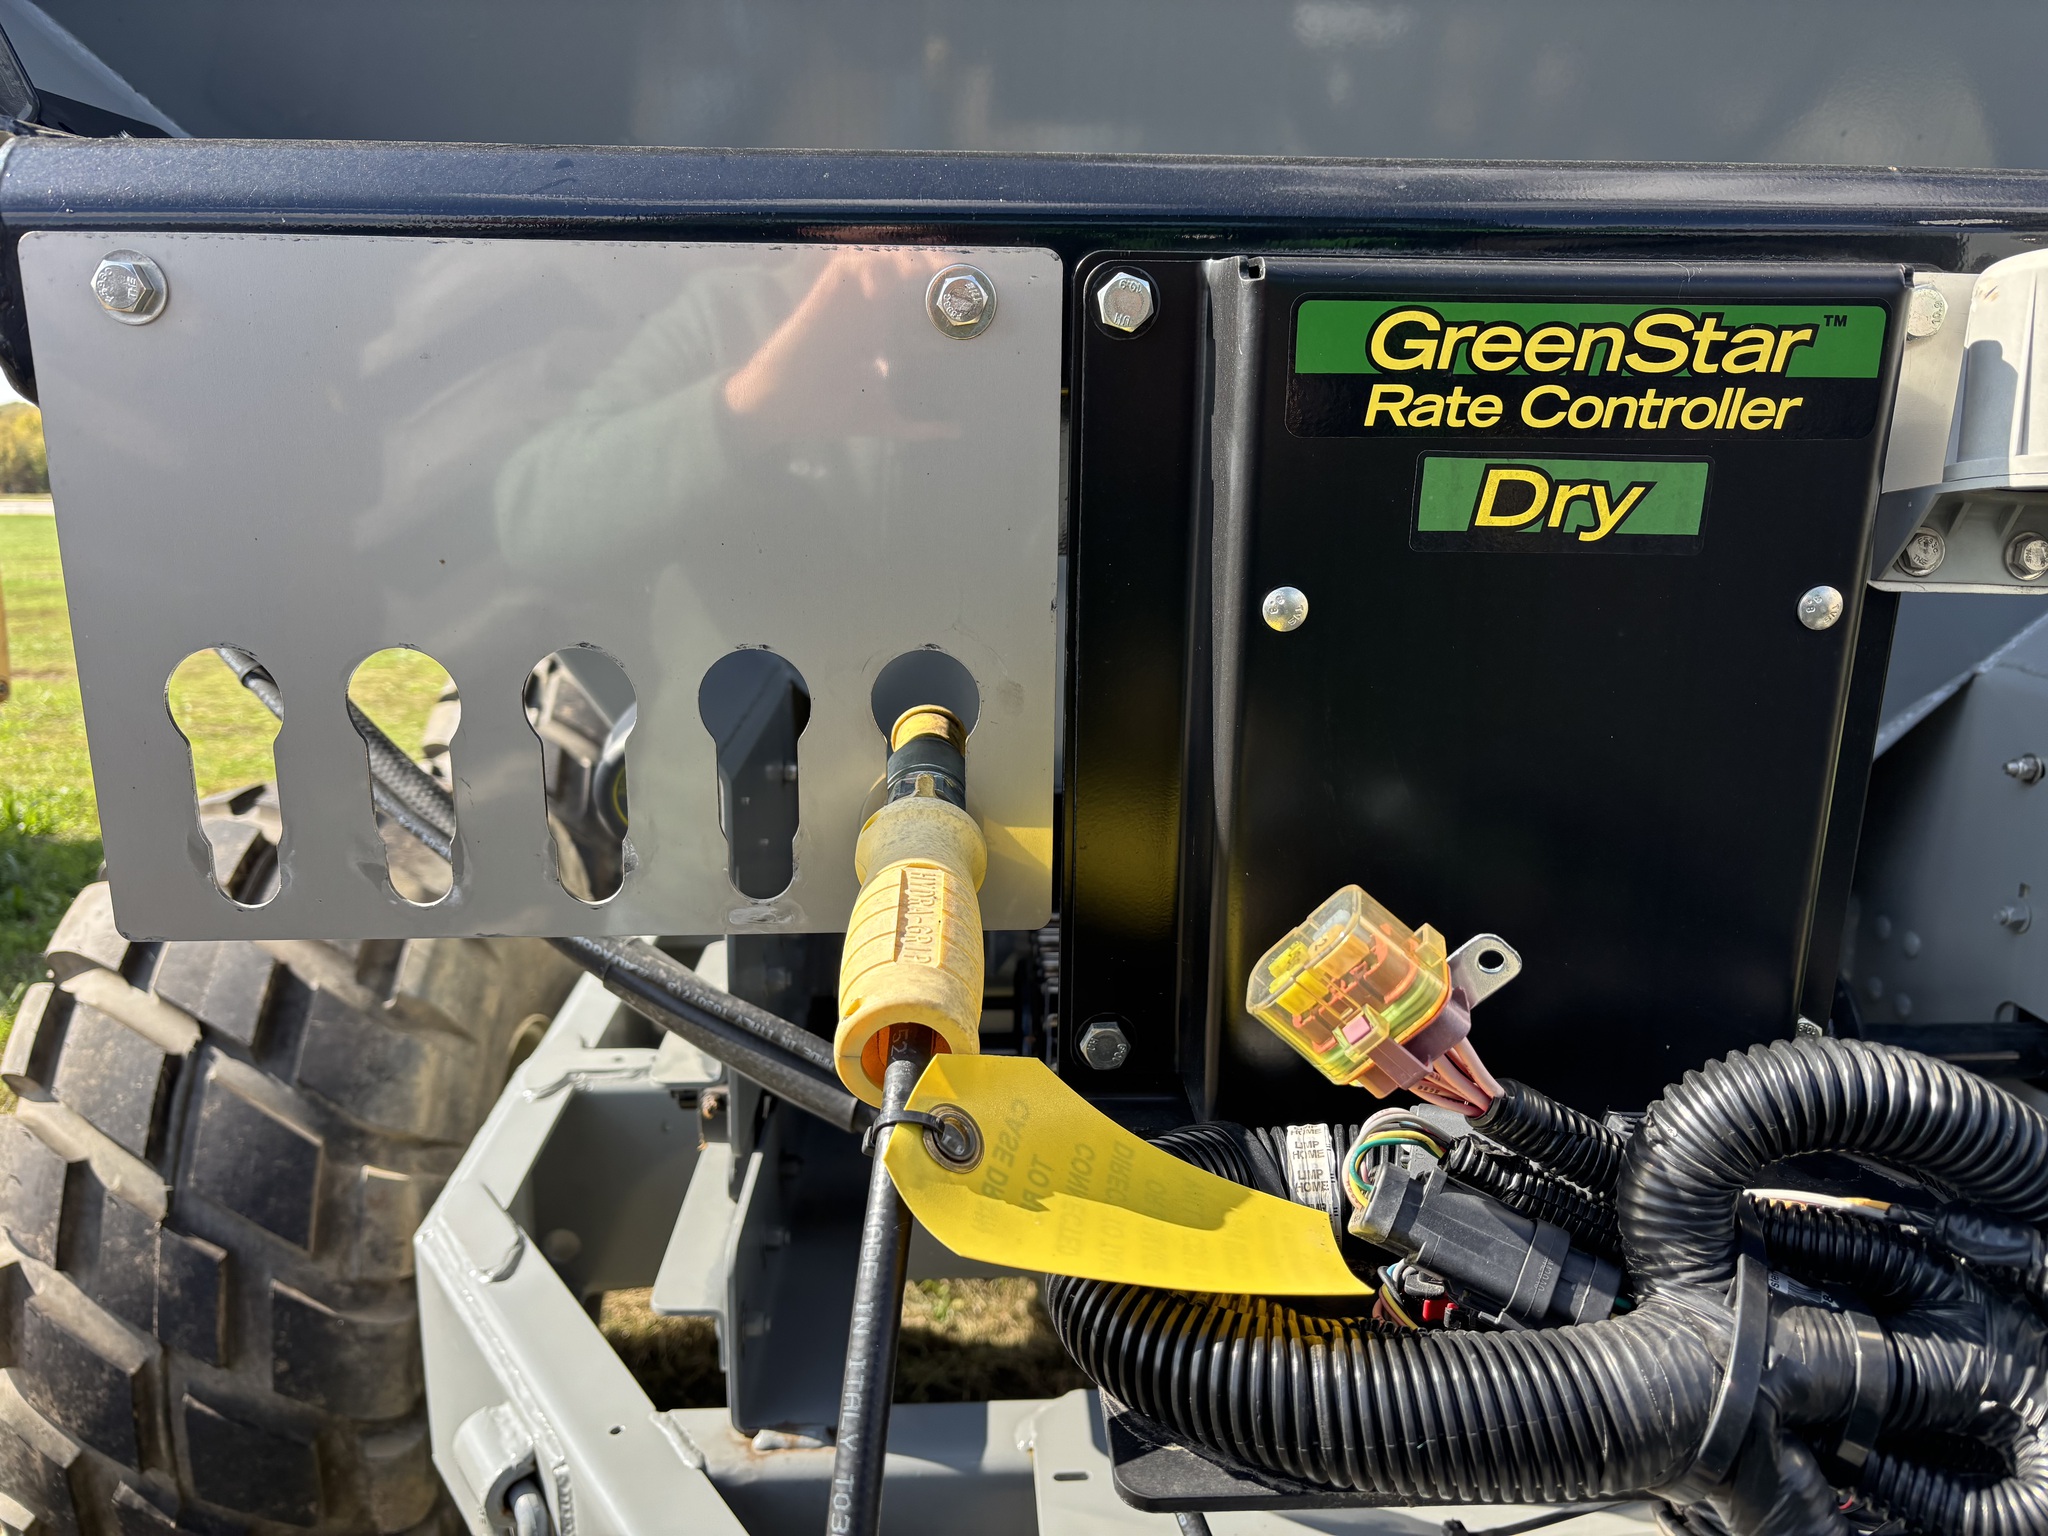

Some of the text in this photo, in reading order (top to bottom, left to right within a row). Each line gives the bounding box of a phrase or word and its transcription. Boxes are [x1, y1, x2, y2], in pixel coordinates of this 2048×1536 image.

[1368, 309, 1815, 375] GreenStar
[1363, 383, 1804, 431] Rate Controller
[1474, 468, 1646, 542] Dry
[902, 869, 938, 966] HYDRA-GRIP
[1295, 1180, 1330, 1193] HOME
[852, 1300, 874, 1336] IN
[838, 1357, 867, 1453] ITALY
